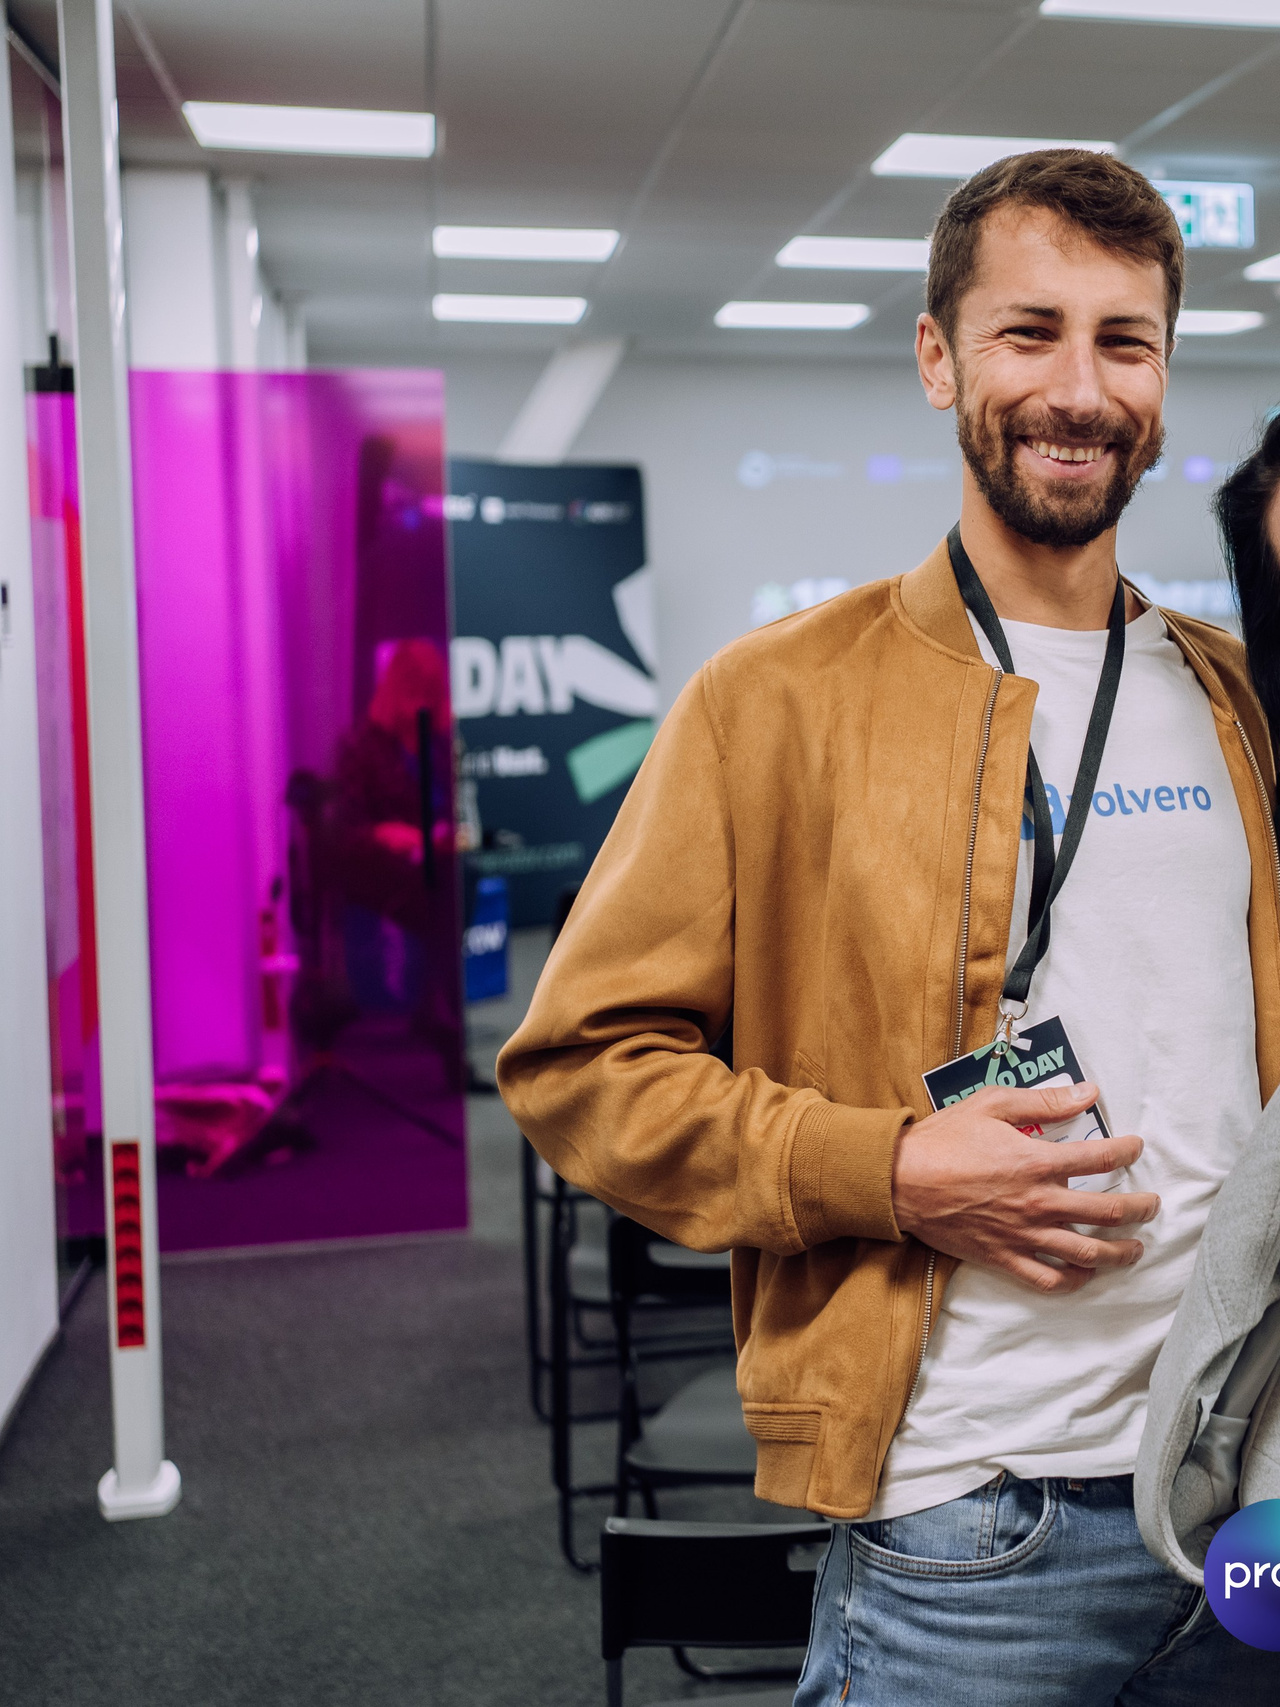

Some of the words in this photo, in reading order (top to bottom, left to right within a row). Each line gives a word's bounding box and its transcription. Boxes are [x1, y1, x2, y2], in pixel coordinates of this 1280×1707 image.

[450, 634, 577, 718] DAY
[1066, 783, 1212, 817] olvero
[1018, 1045, 1066, 1084] DAY
